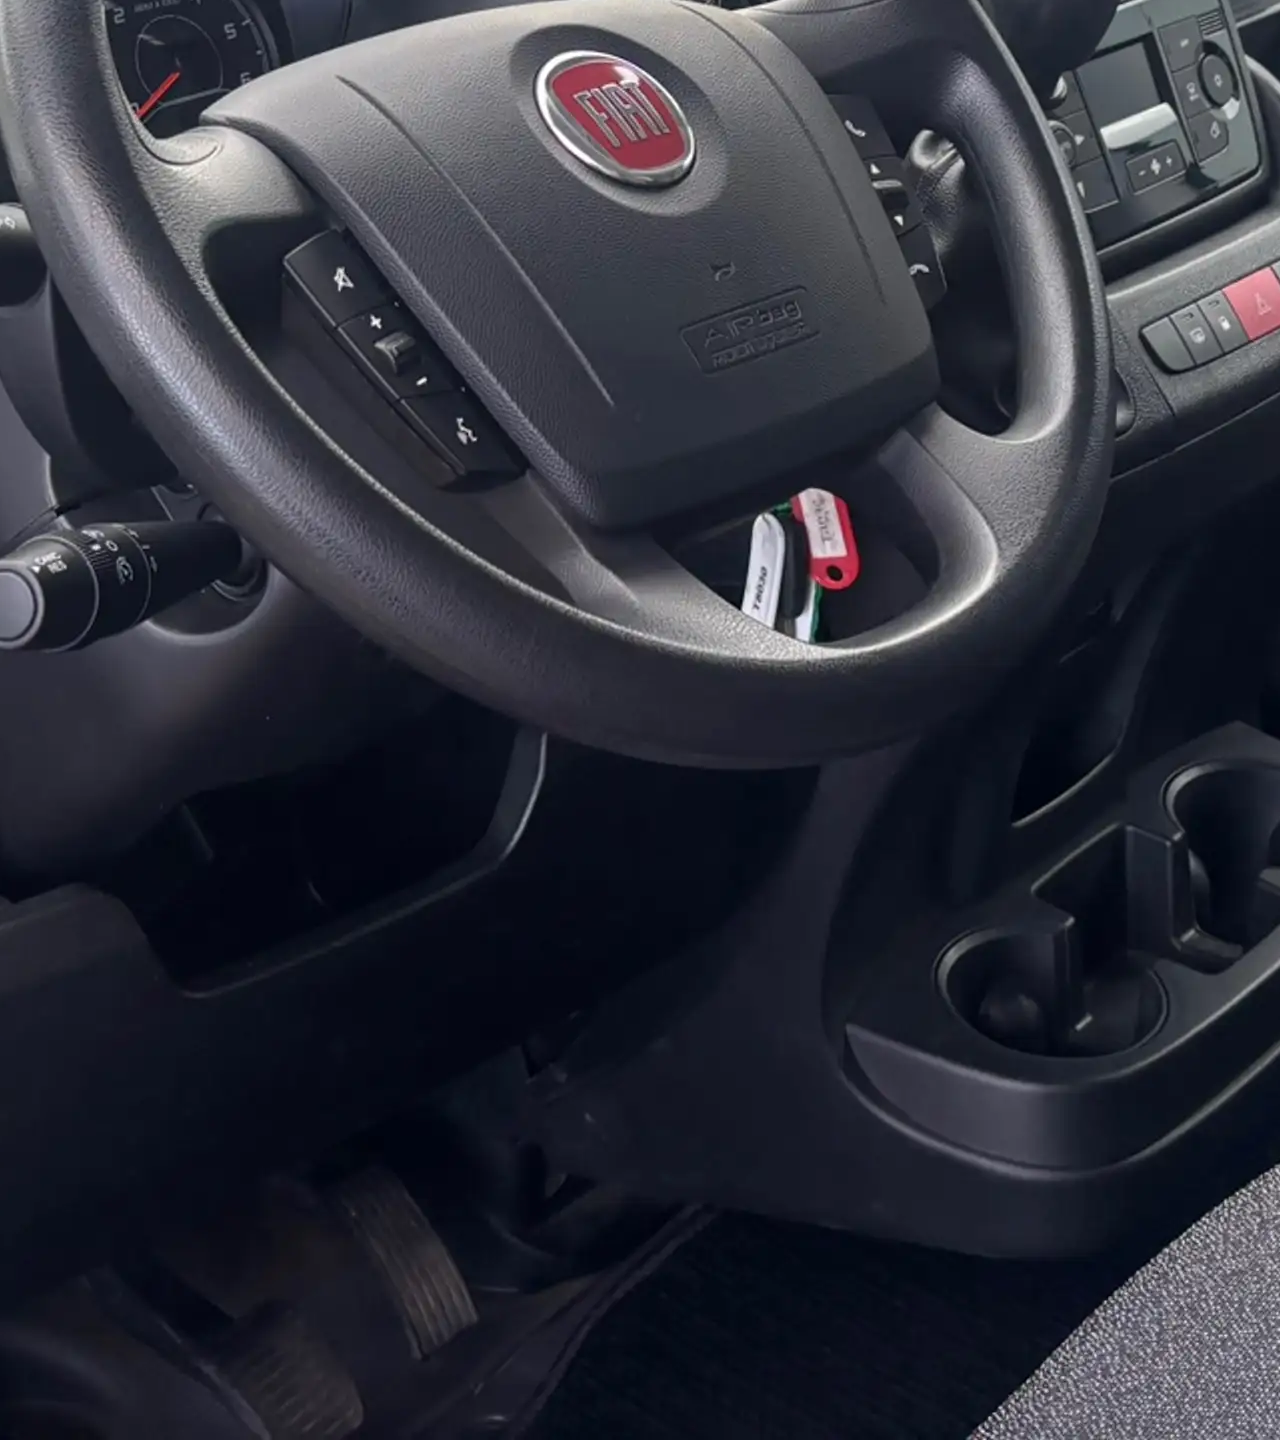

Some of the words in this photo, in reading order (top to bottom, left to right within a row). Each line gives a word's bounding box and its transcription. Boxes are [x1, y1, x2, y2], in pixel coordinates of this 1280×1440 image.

[113, 7, 126, 24] 2
[223, 22, 238, 40] 5
[573, 80, 670, 149] FIAT
